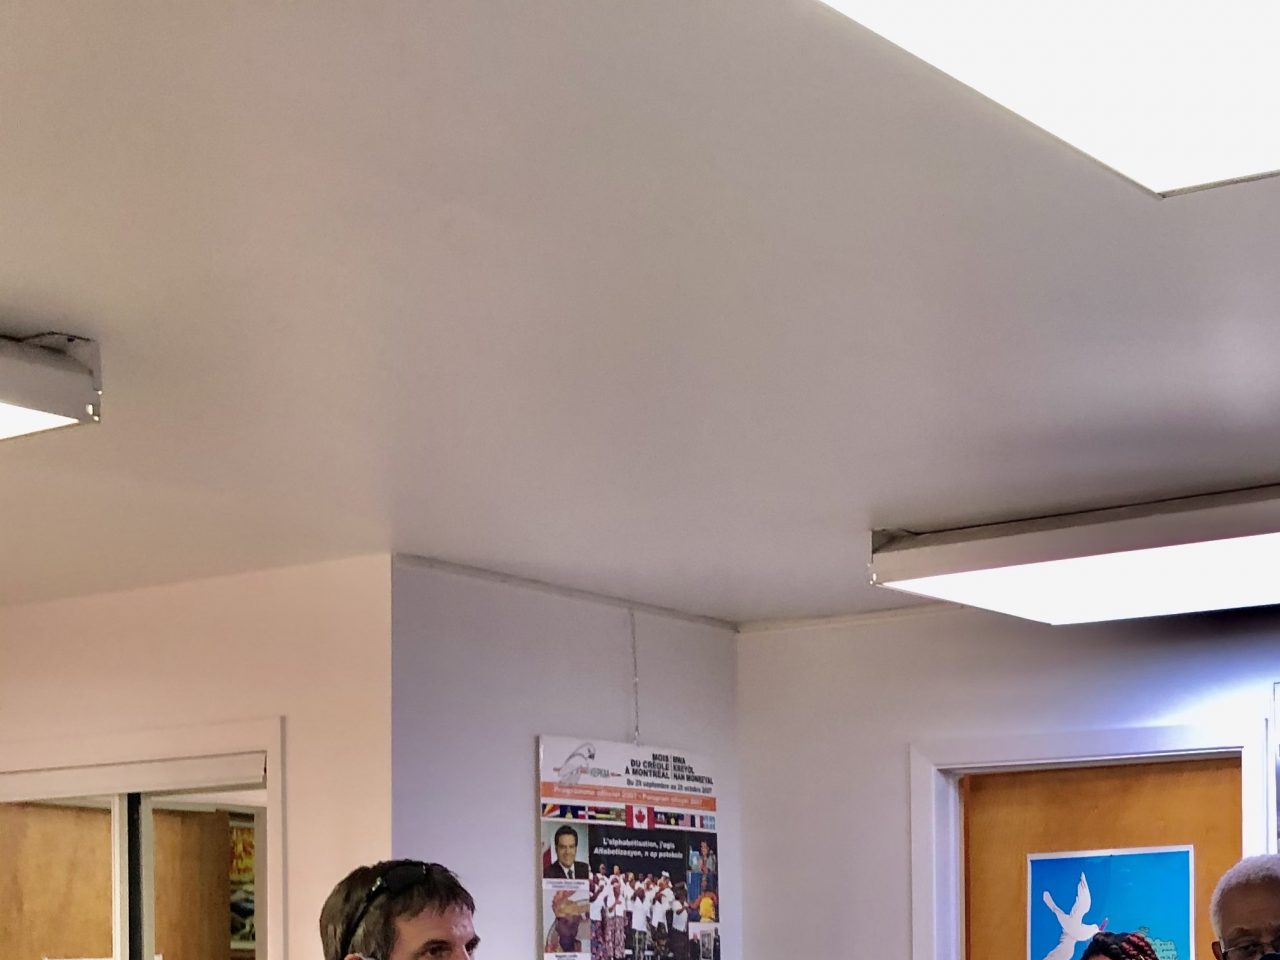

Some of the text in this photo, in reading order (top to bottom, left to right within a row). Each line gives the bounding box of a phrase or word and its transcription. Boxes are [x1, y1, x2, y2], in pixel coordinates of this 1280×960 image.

[652, 753, 669, 762] MOIS
[672, 756, 686, 765] MWA
[630, 758, 670, 771] DU CRÉOLE
[625, 766, 670, 780] À MONTRÉAL
